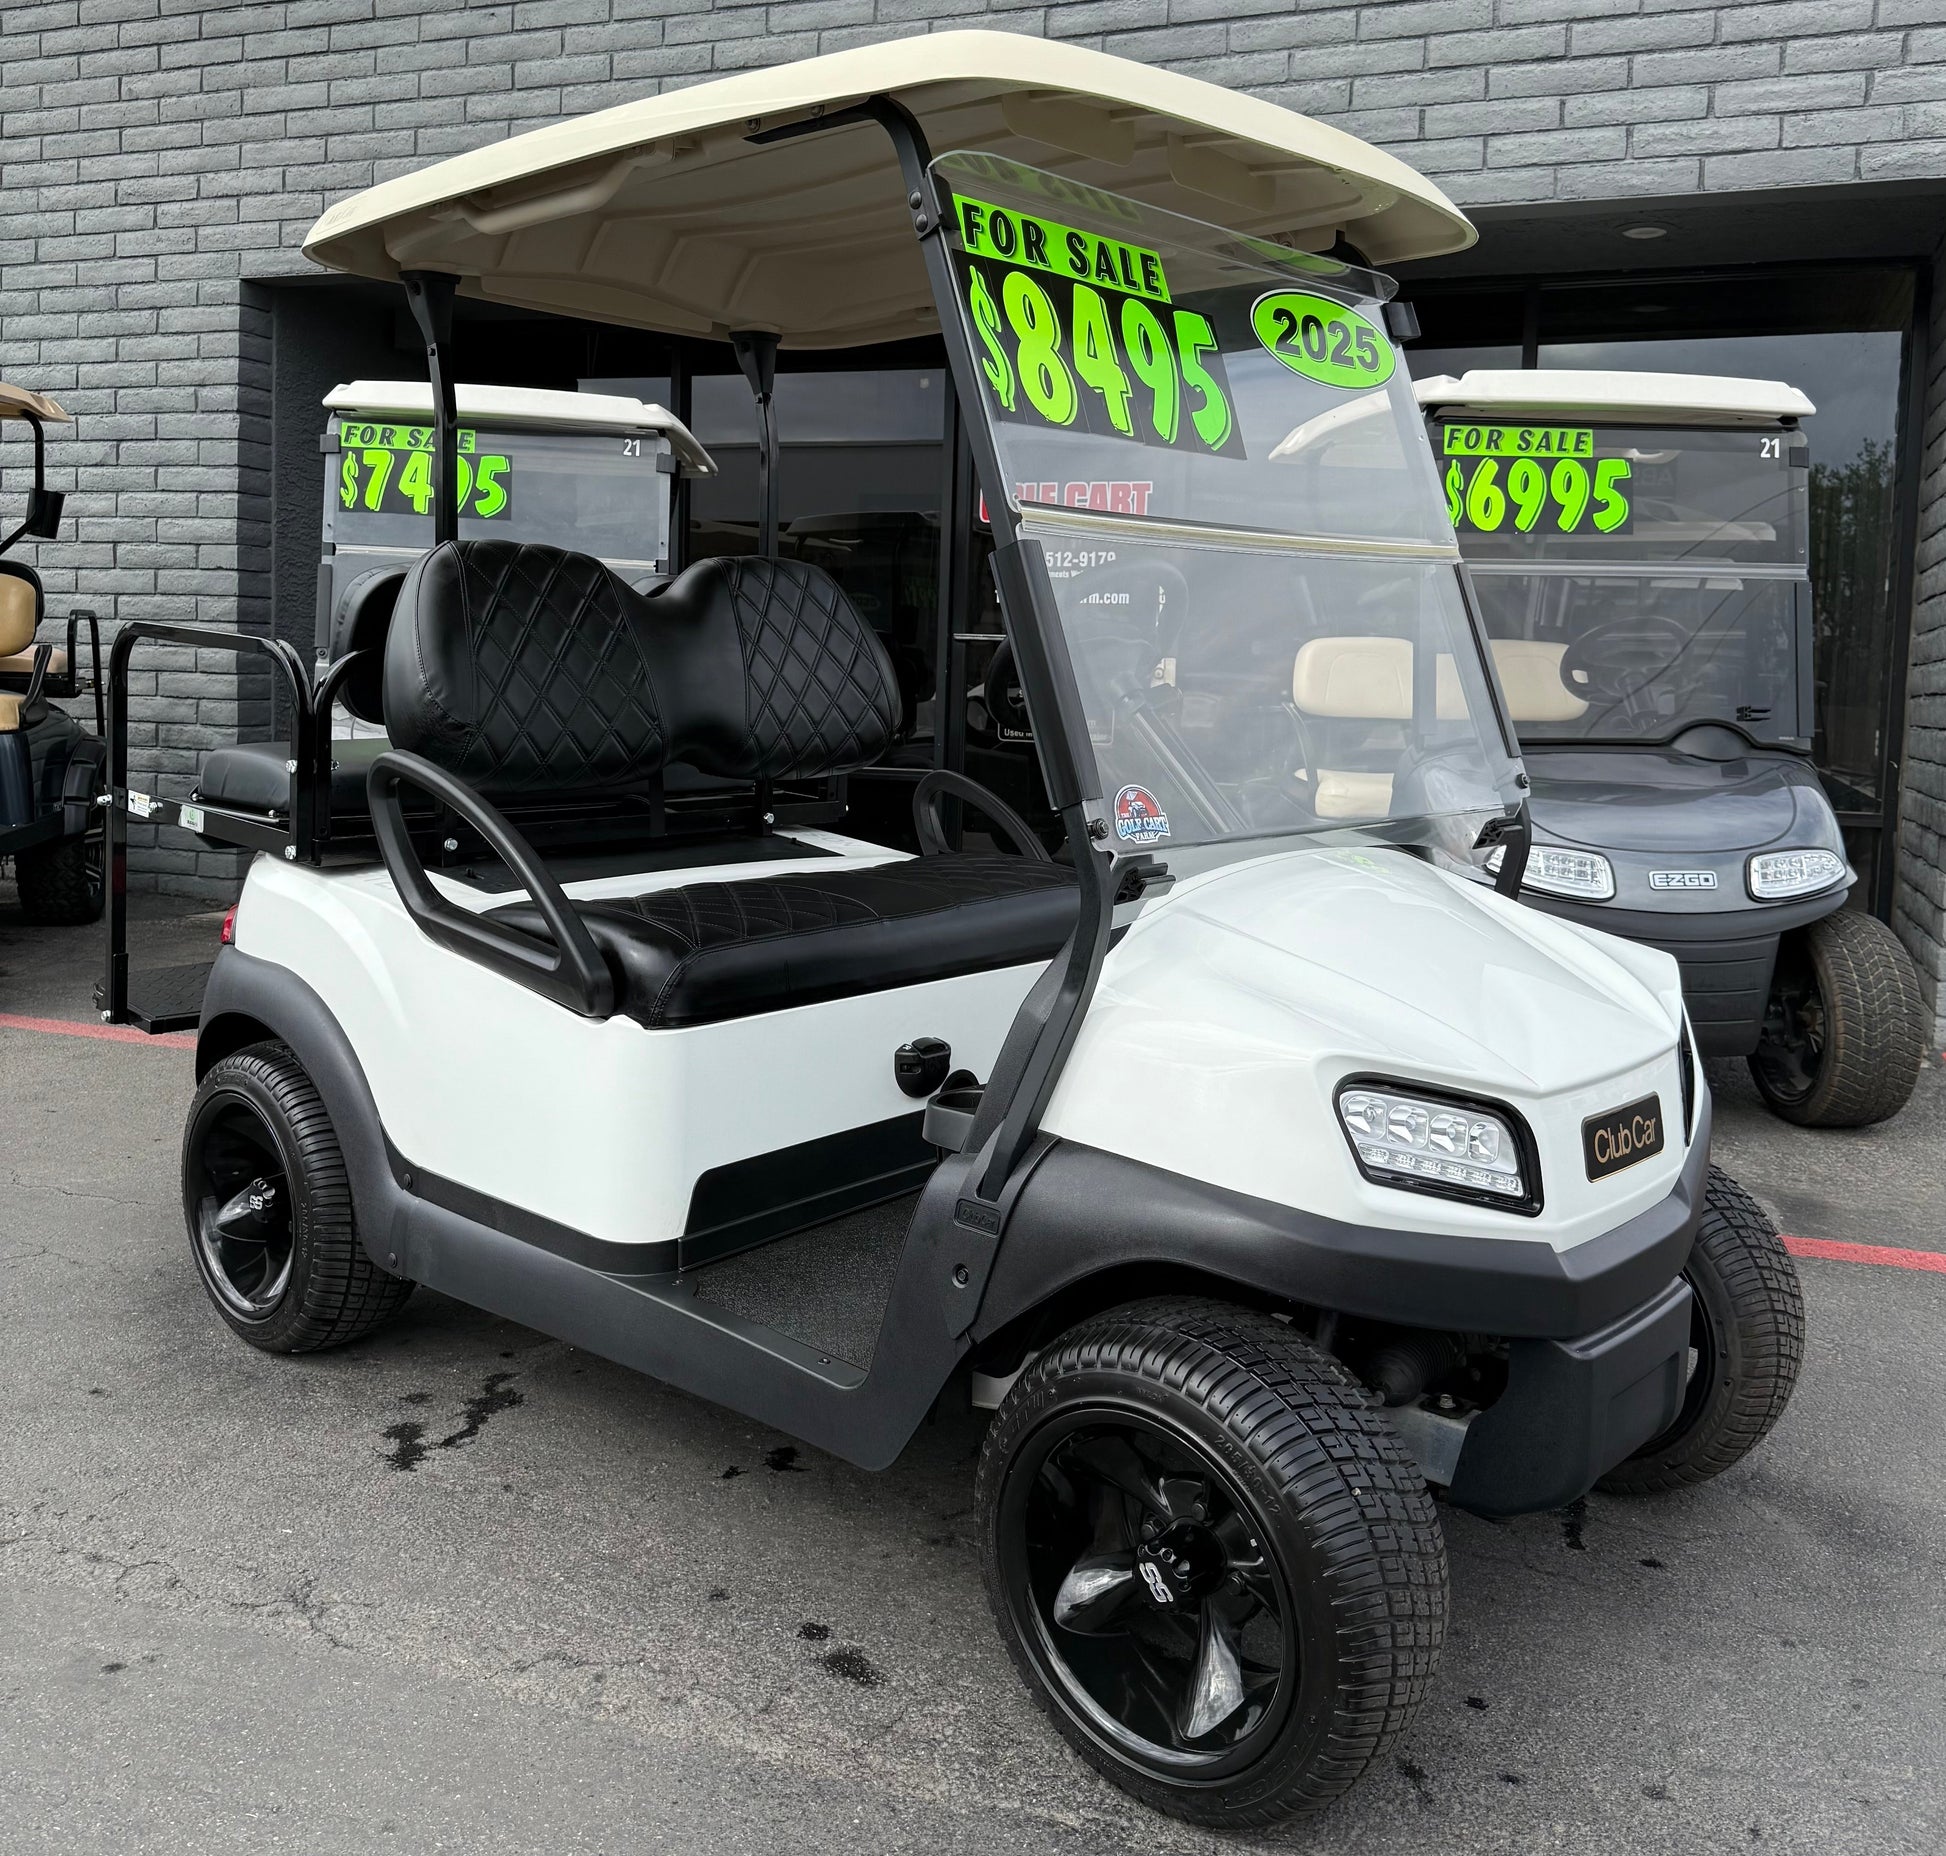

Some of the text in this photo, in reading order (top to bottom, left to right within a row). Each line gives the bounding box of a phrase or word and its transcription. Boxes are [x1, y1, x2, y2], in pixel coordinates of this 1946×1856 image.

[961, 201, 1161, 295] FOR SALE
[1272, 307, 1380, 373] 2025
[969, 265, 1232, 452] $8495
[343, 425, 474, 453] FOR SAE
[622, 438, 641, 457] 21
[1446, 427, 1590, 454] FOR SALE
[1759, 438, 1780, 459] 21
[1445, 457, 1634, 534] $6995
[1118, 816, 1167, 836] GOLF CART
[1653, 873, 1715, 887] EZGO
[1594, 1114, 1656, 1164] Club Car
[1138, 1561, 1174, 1603] SS
